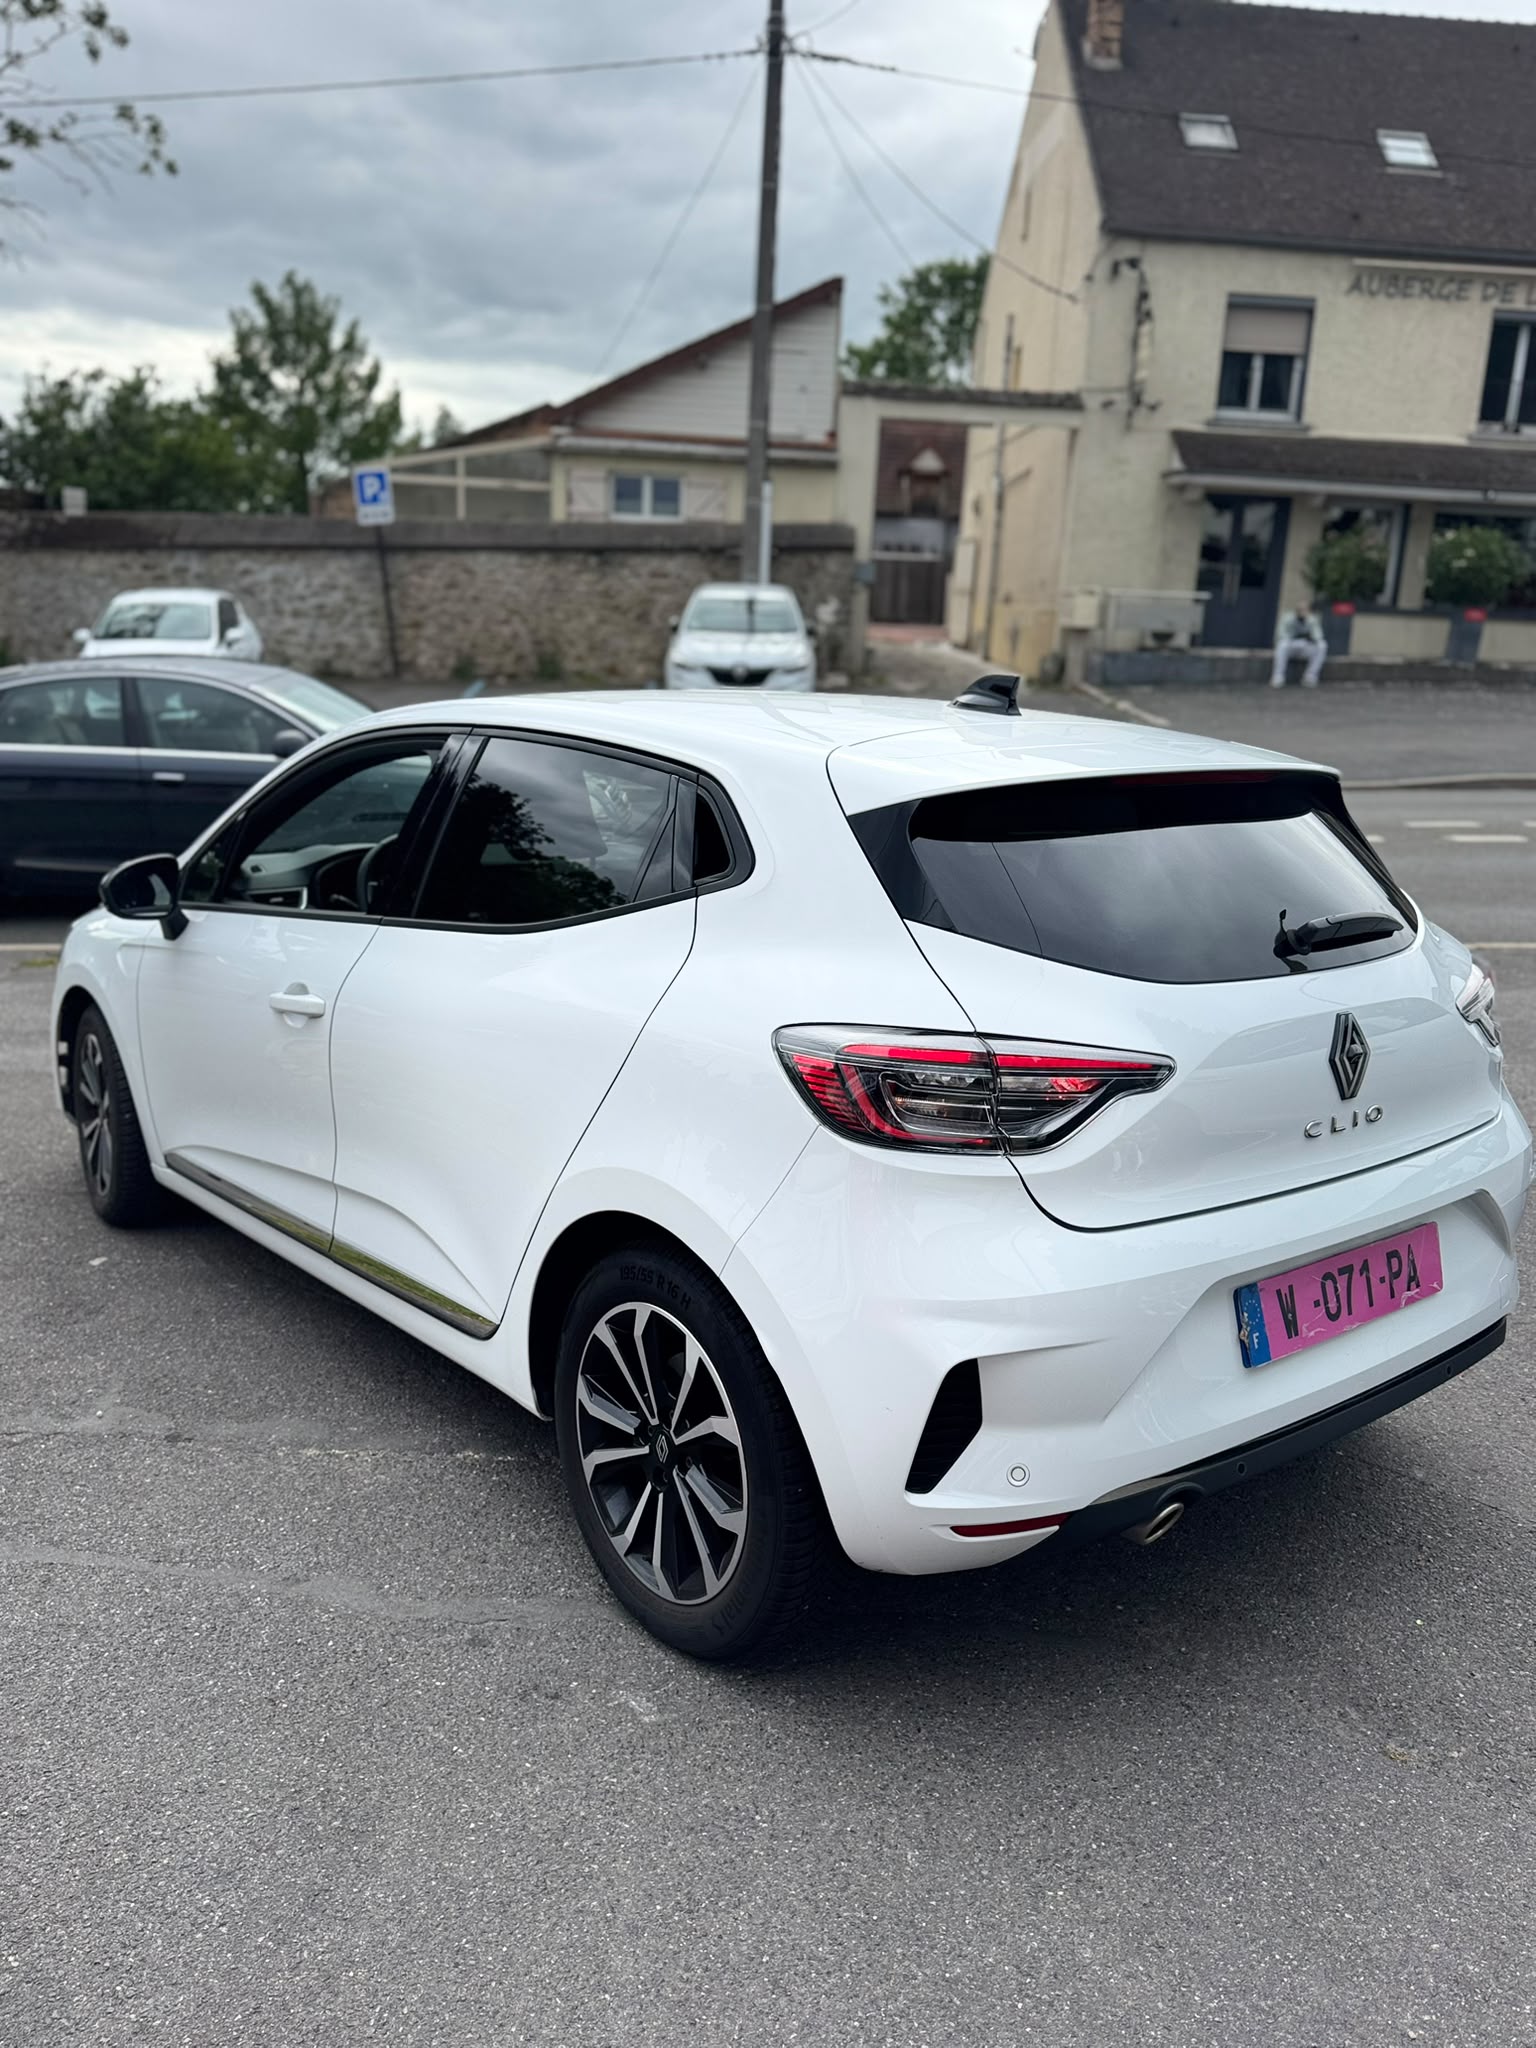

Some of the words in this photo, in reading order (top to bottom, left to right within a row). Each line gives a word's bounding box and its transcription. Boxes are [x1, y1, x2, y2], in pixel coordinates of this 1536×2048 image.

[1347, 272, 1472, 301] AUBERGE
[1481, 280, 1517, 302] DE
[363, 476, 380, 499] P
[1304, 1104, 1383, 1138] CLIO
[656, 1274, 665, 1289] R
[667, 1279, 680, 1299] 16
[1252, 1332, 1259, 1349] F
